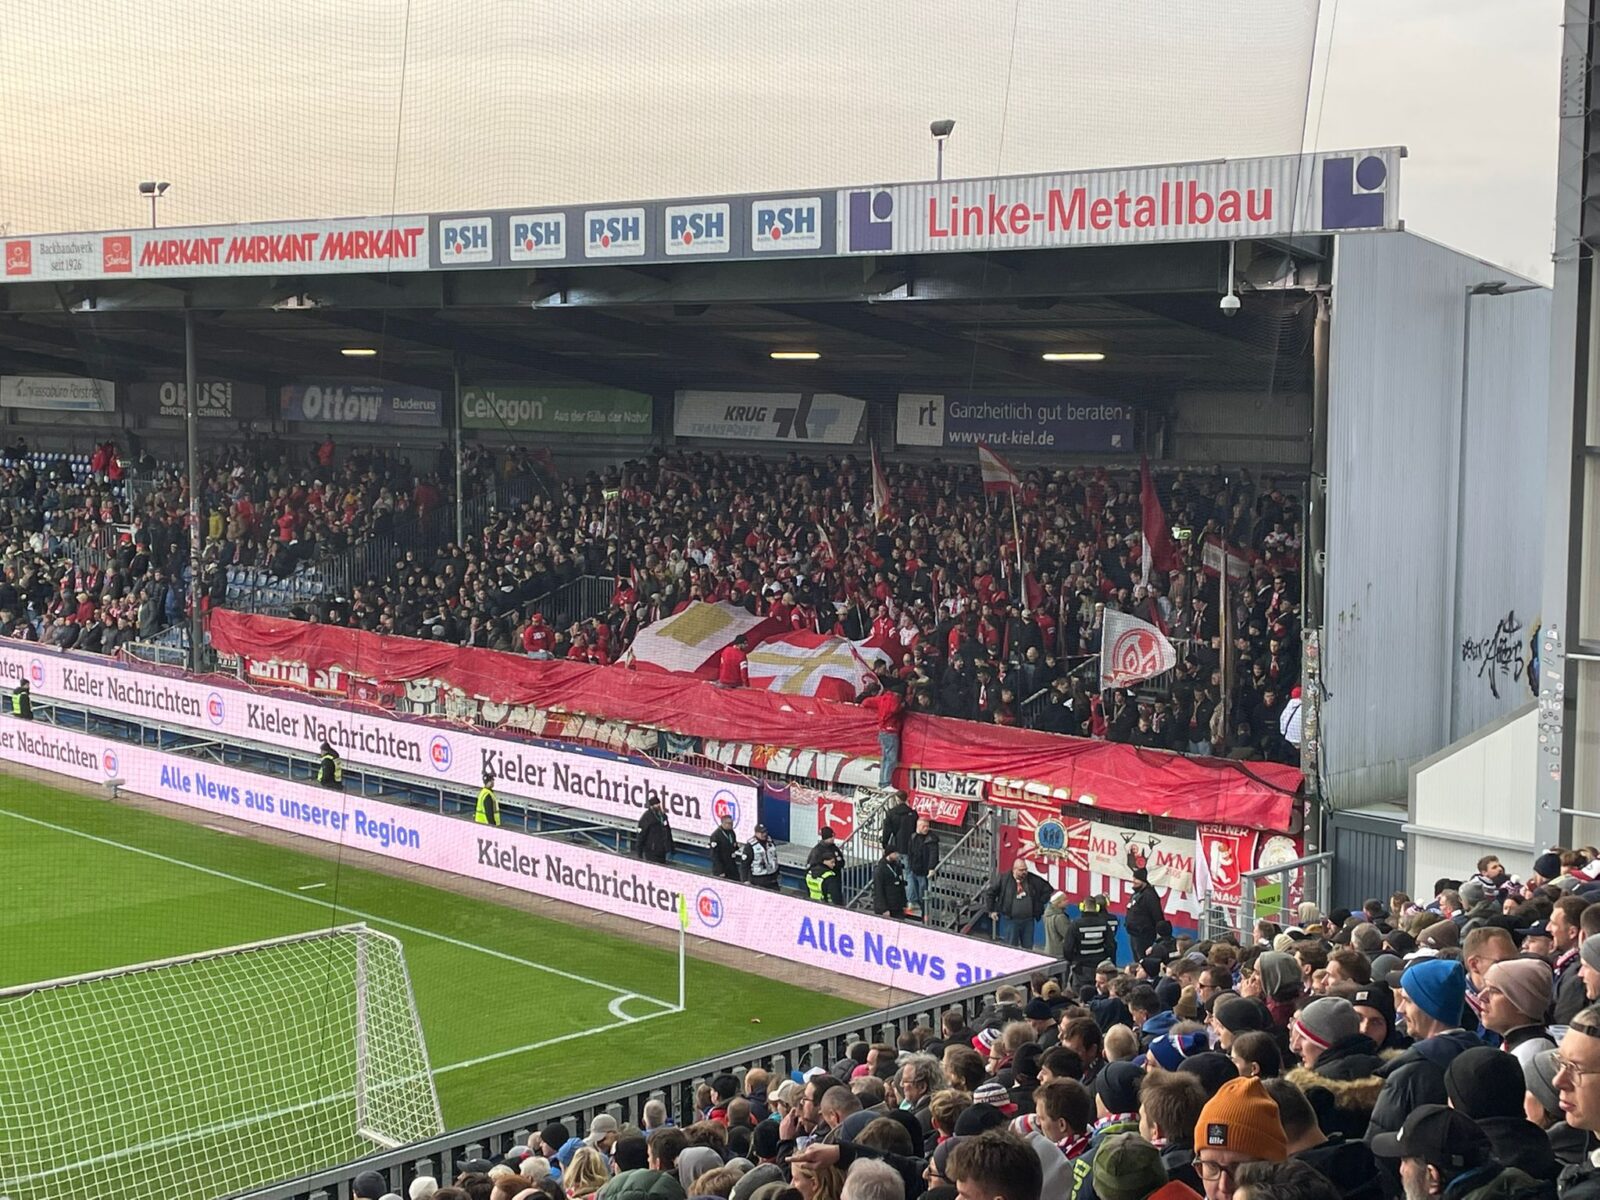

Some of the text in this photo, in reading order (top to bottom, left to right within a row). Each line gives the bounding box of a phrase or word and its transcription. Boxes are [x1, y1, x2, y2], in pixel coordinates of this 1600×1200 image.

[671, 212, 724, 239] RSH
[758, 207, 815, 235] RSH
[928, 182, 1274, 239] Linke-Metallbau
[444, 226, 487, 250] RSH
[514, 221, 560, 246] RSH
[589, 216, 640, 243] RSH
[139, 237, 225, 267] MARKANT
[225, 233, 320, 264] MARKANT
[320, 228, 424, 261] MARKANT
[392, 397, 436, 411] Buderus
[462, 392, 543, 426] Cellagon
[723, 405, 768, 422] KRUG
[918, 400, 937, 426] rt
[949, 401, 1033, 420] Ganzheitlich
[1038, 405, 1062, 425] gut
[949, 430, 1055, 446] www.rut-kiel.de
[62, 668, 104, 697] Kieler
[107, 676, 201, 718] Nachrichten
[247, 703, 299, 738] Kieler
[302, 710, 421, 763] Nachrichten
[17, 730, 98, 770] Nachrichten
[481, 748, 547, 788] Kieler
[552, 762, 701, 821] Nachrichten
[920, 771, 937, 789] SD
[955, 777, 979, 796] MZ
[160, 765, 421, 849] Alle News aus unserer Region
[477, 838, 541, 878] Kieler
[1091, 836, 1193, 873] MB MM
[797, 916, 1008, 987] Alle News au
